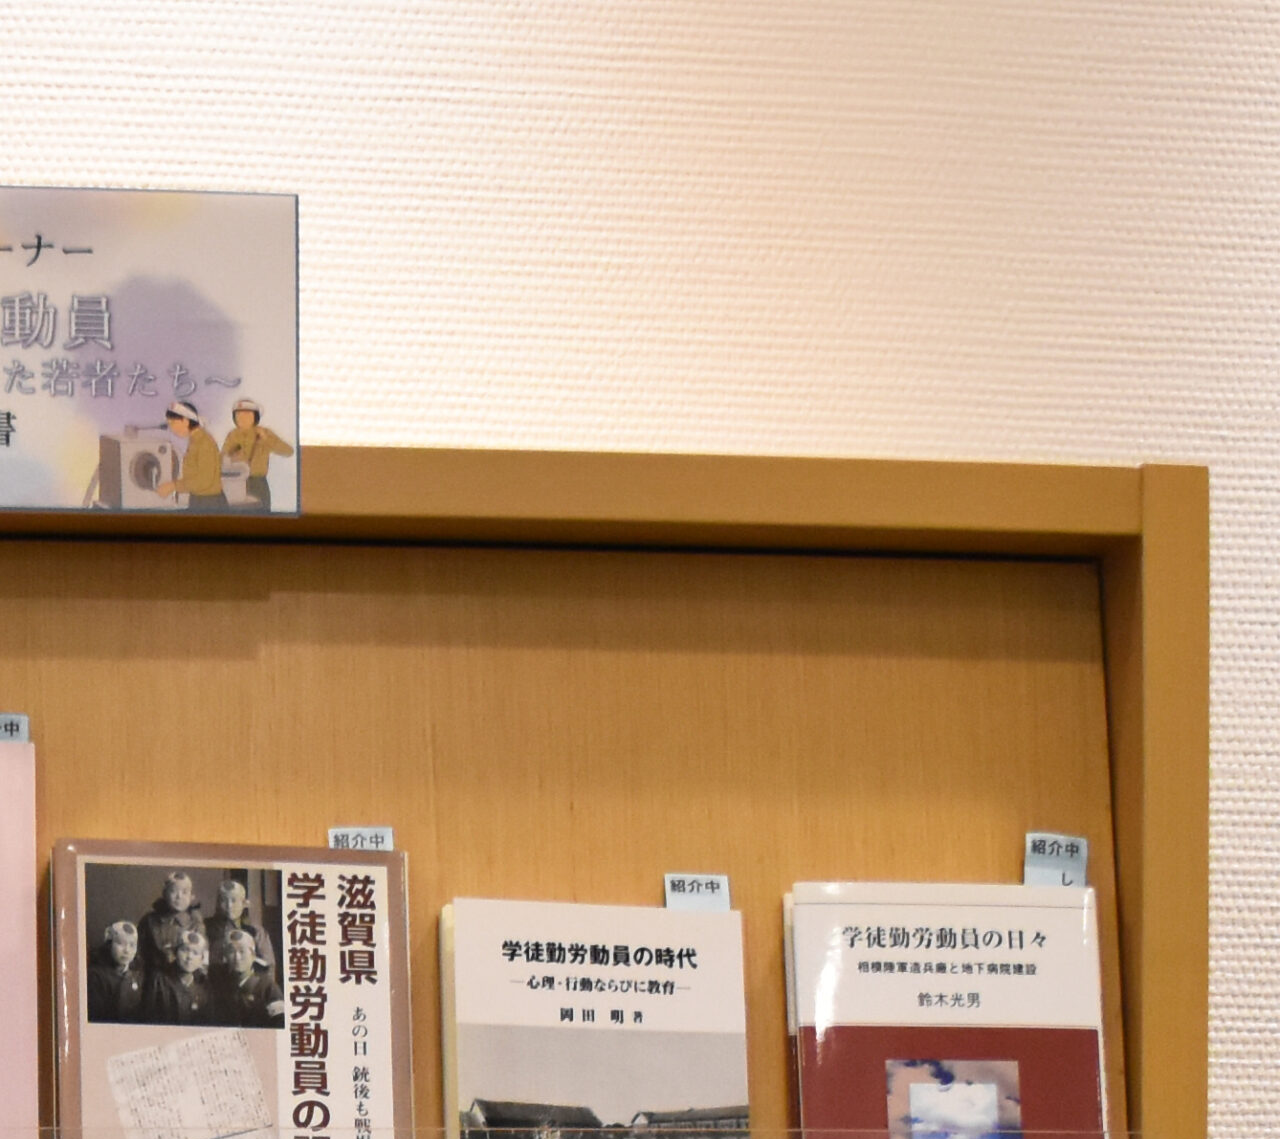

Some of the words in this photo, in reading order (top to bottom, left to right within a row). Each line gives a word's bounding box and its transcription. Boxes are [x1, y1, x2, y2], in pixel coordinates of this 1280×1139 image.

[332, 832, 386, 849] 紹介中
[1030, 838, 1081, 859] 紹介中
[670, 878, 721, 894] 紹介中
[337, 873, 379, 986] 滋賀県
[841, 925, 1049, 951] 学徒勤労動員の日々
[501, 939, 699, 970] 学徒勤労動員の時代
[916, 992, 982, 1009] 鈴木光男
[351, 1006, 369, 1057] あの日
